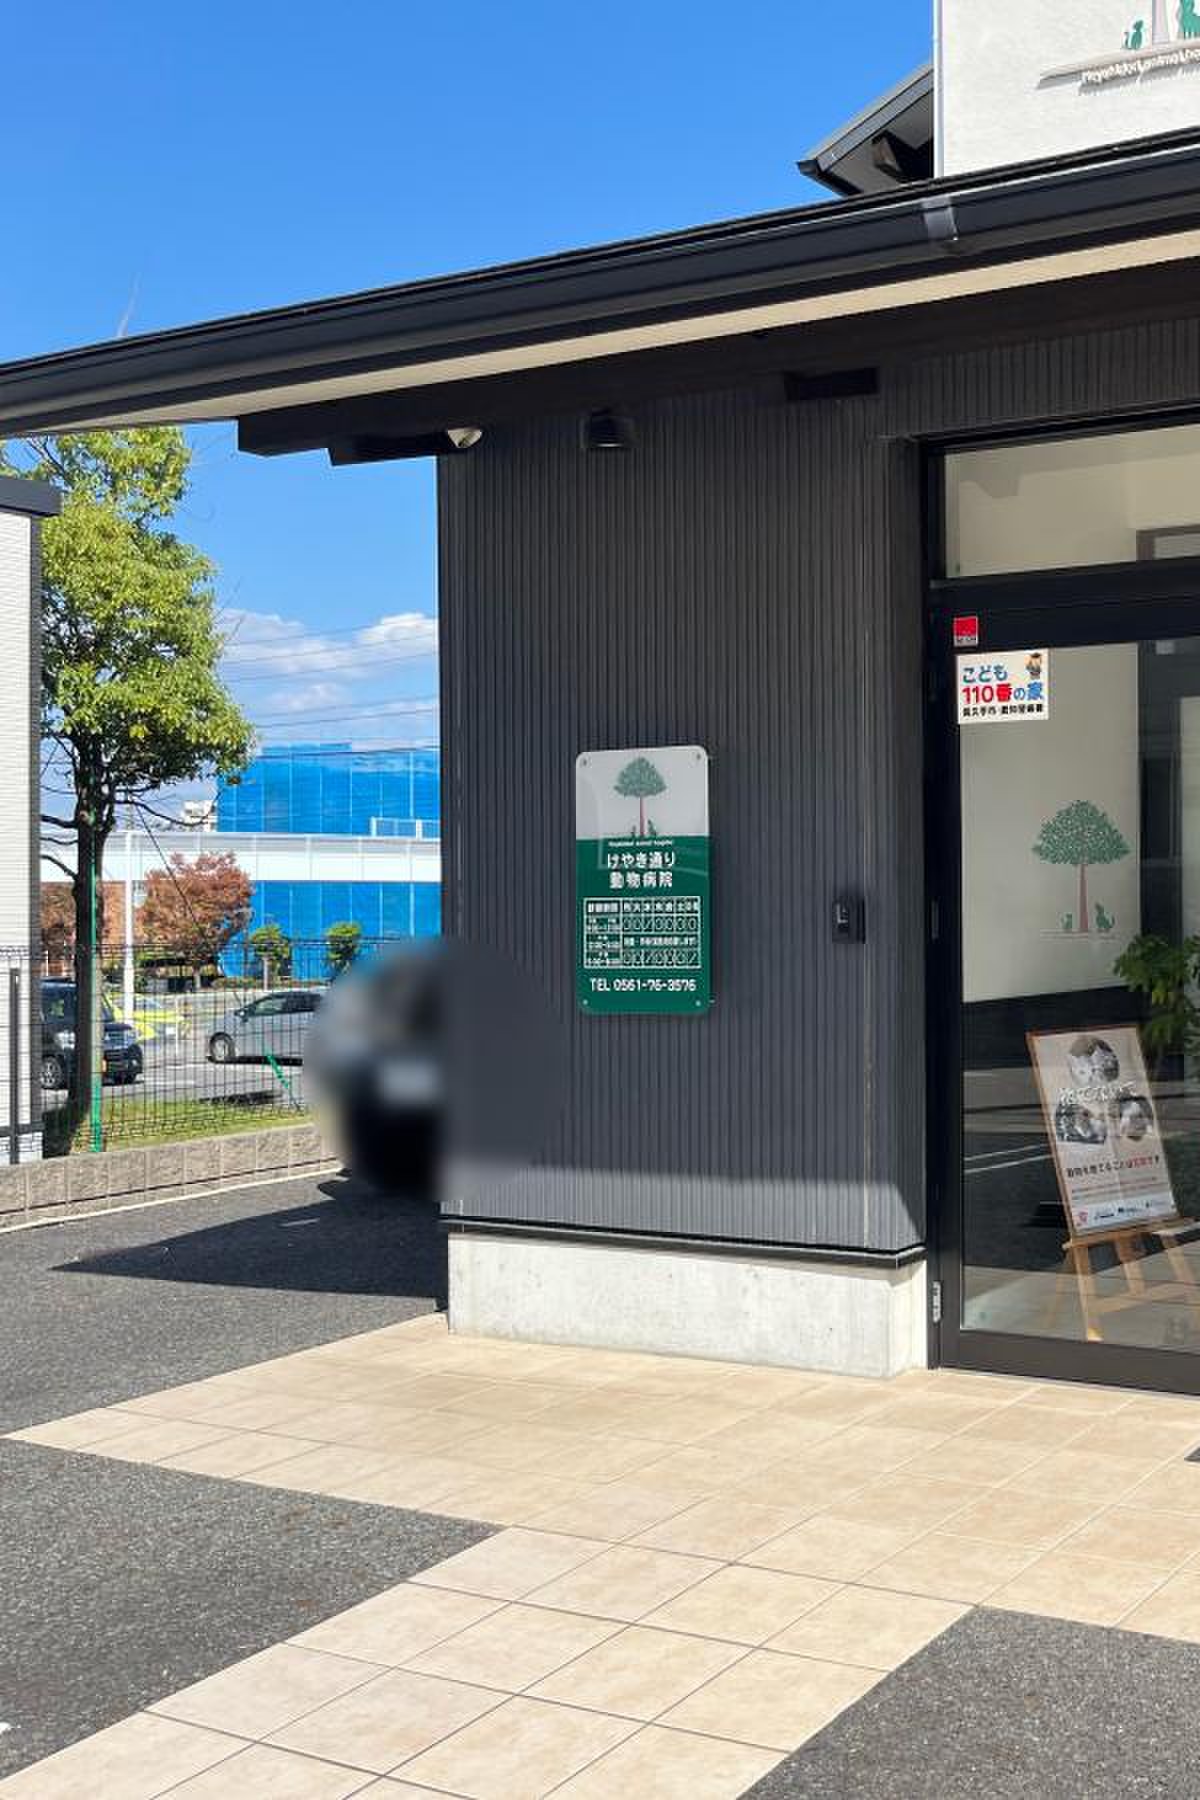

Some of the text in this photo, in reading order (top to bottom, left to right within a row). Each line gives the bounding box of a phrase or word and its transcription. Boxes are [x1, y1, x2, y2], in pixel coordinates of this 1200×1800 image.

[963, 665, 1008, 683] こども
[962, 681, 1044, 704] 110番の家
[608, 851, 676, 869] けやき通り
[610, 871, 673, 889] 動物病院
[590, 978, 697, 992] TEL 0561-76-3576
